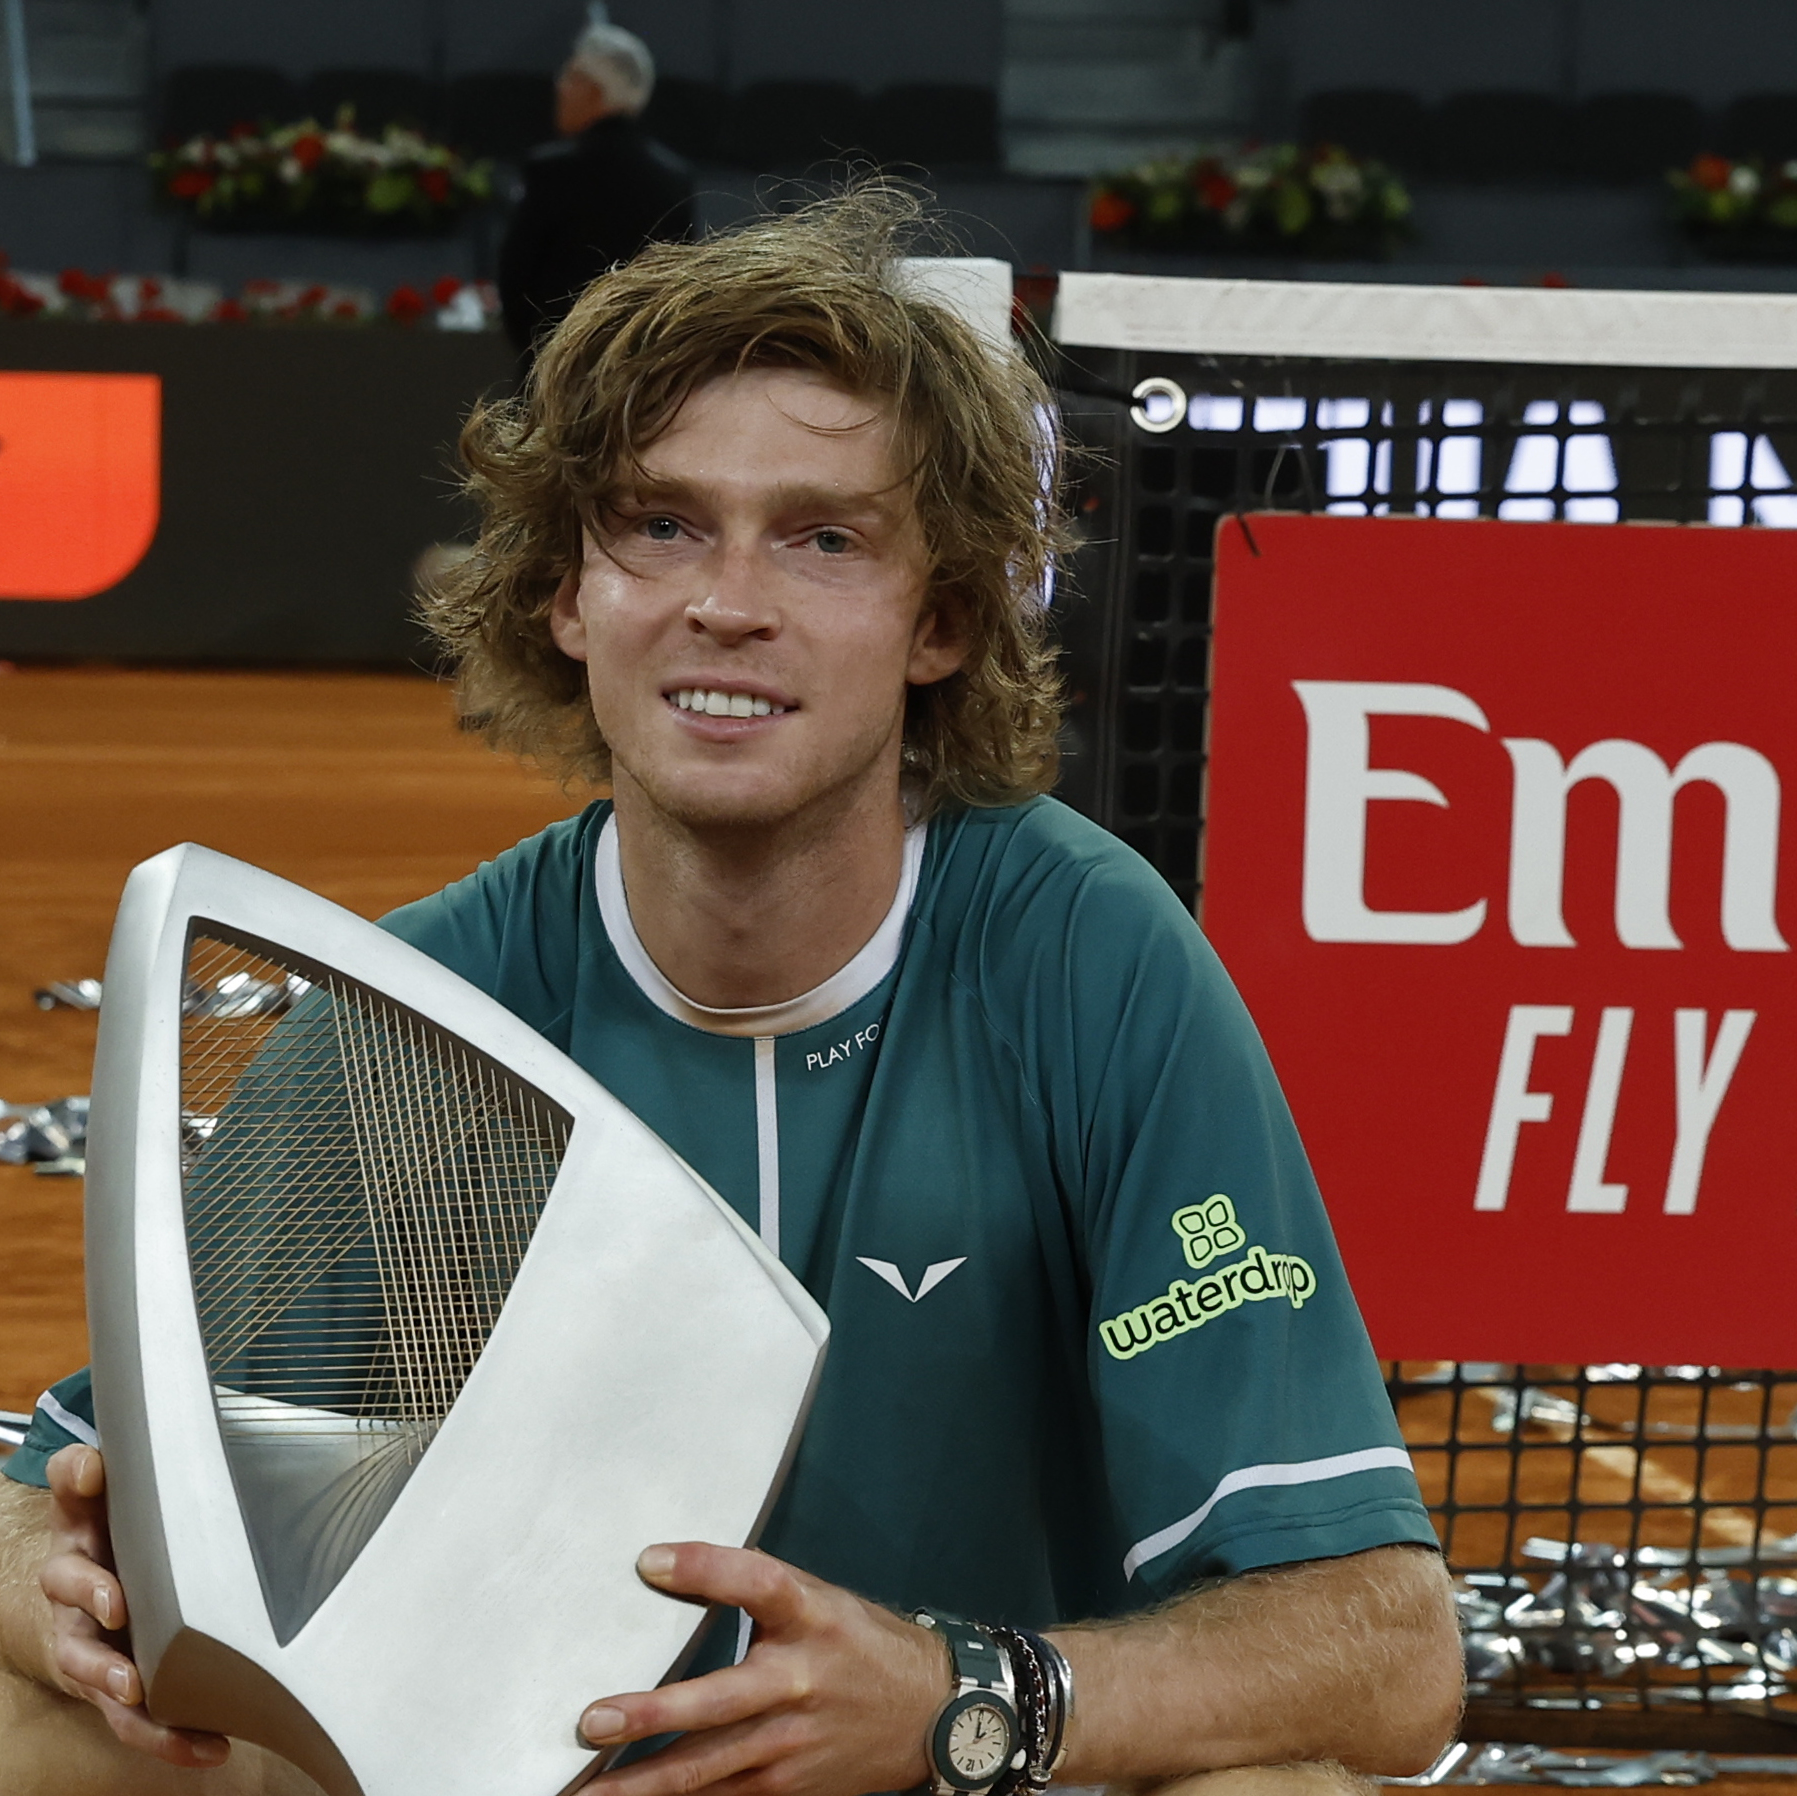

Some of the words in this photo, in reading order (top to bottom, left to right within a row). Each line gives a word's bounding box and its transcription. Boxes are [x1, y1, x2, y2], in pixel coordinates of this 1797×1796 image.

[806, 1039, 852, 1072] PLAY
[854, 1016, 884, 1051] FO
[1474, 1005, 1756, 1215] FLY
[1105, 1252, 1311, 1354] waterdrop
